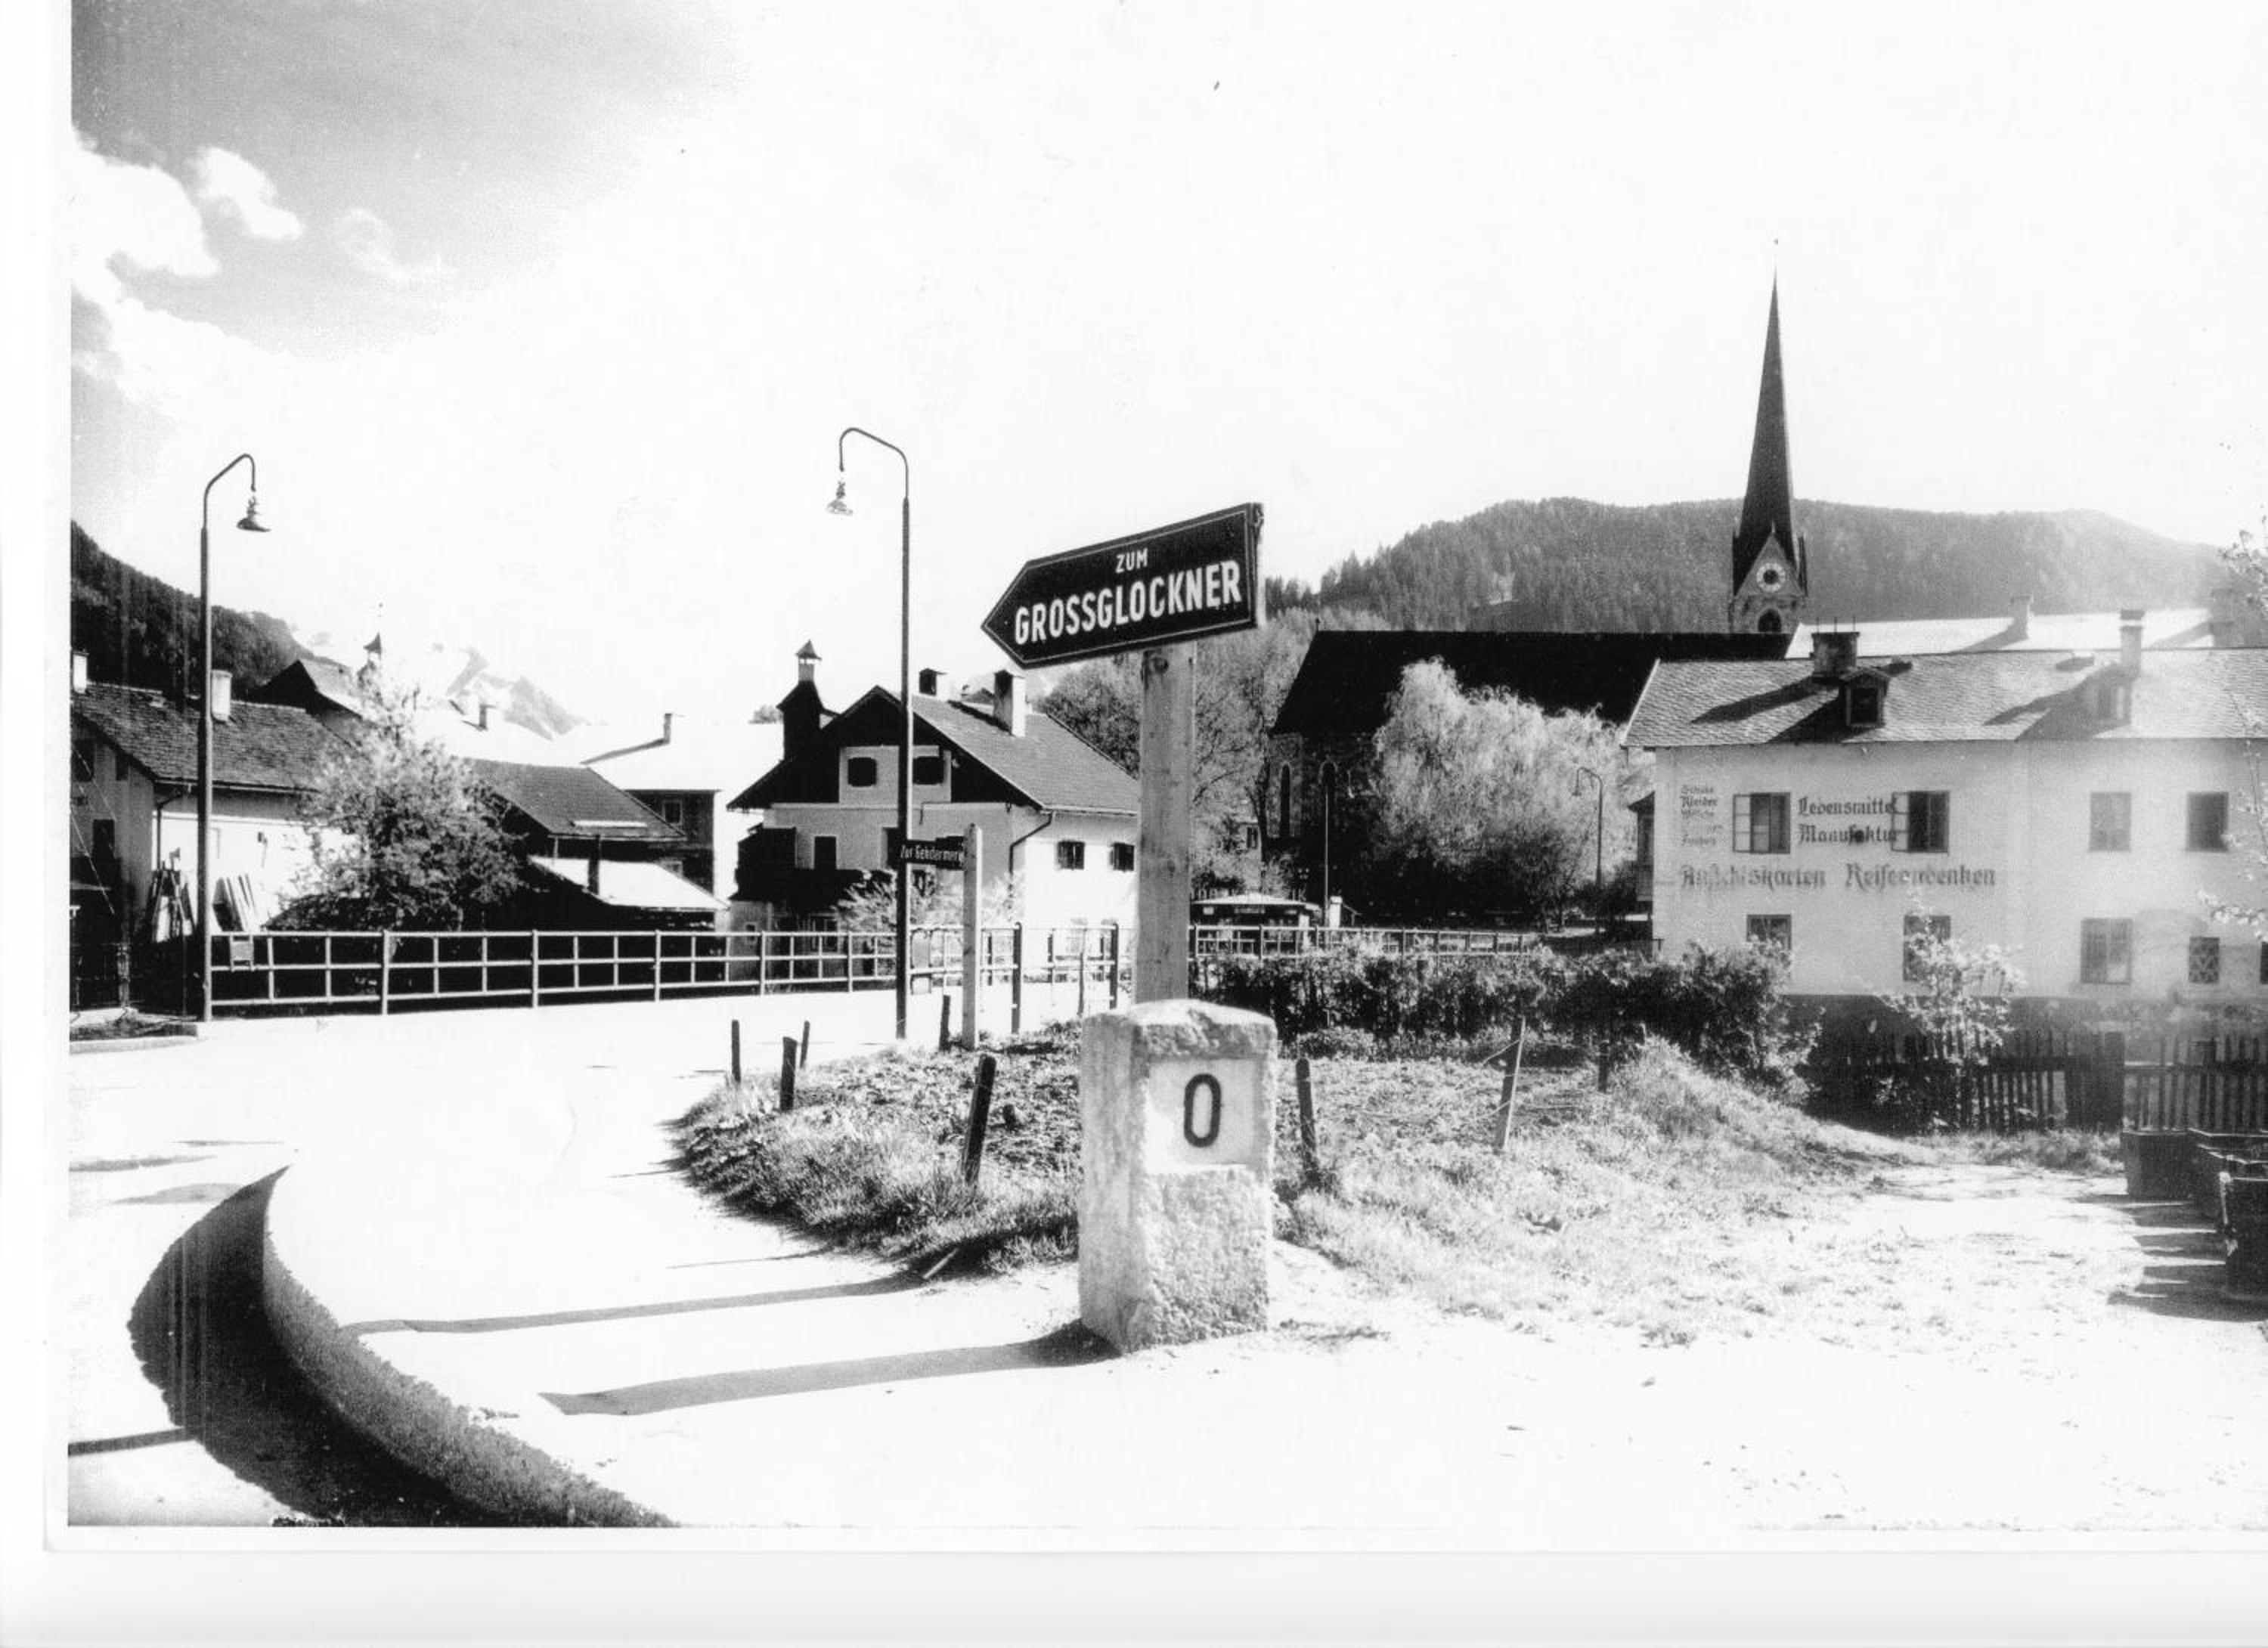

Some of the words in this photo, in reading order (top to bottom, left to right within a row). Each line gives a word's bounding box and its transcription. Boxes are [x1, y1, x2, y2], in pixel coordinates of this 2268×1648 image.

[1115, 547, 1148, 574] ZUM
[1014, 559, 1242, 646] GROSSGLOCKNER
[1798, 823, 1896, 844] Manufktur
[1184, 1073, 1222, 1148] 0
